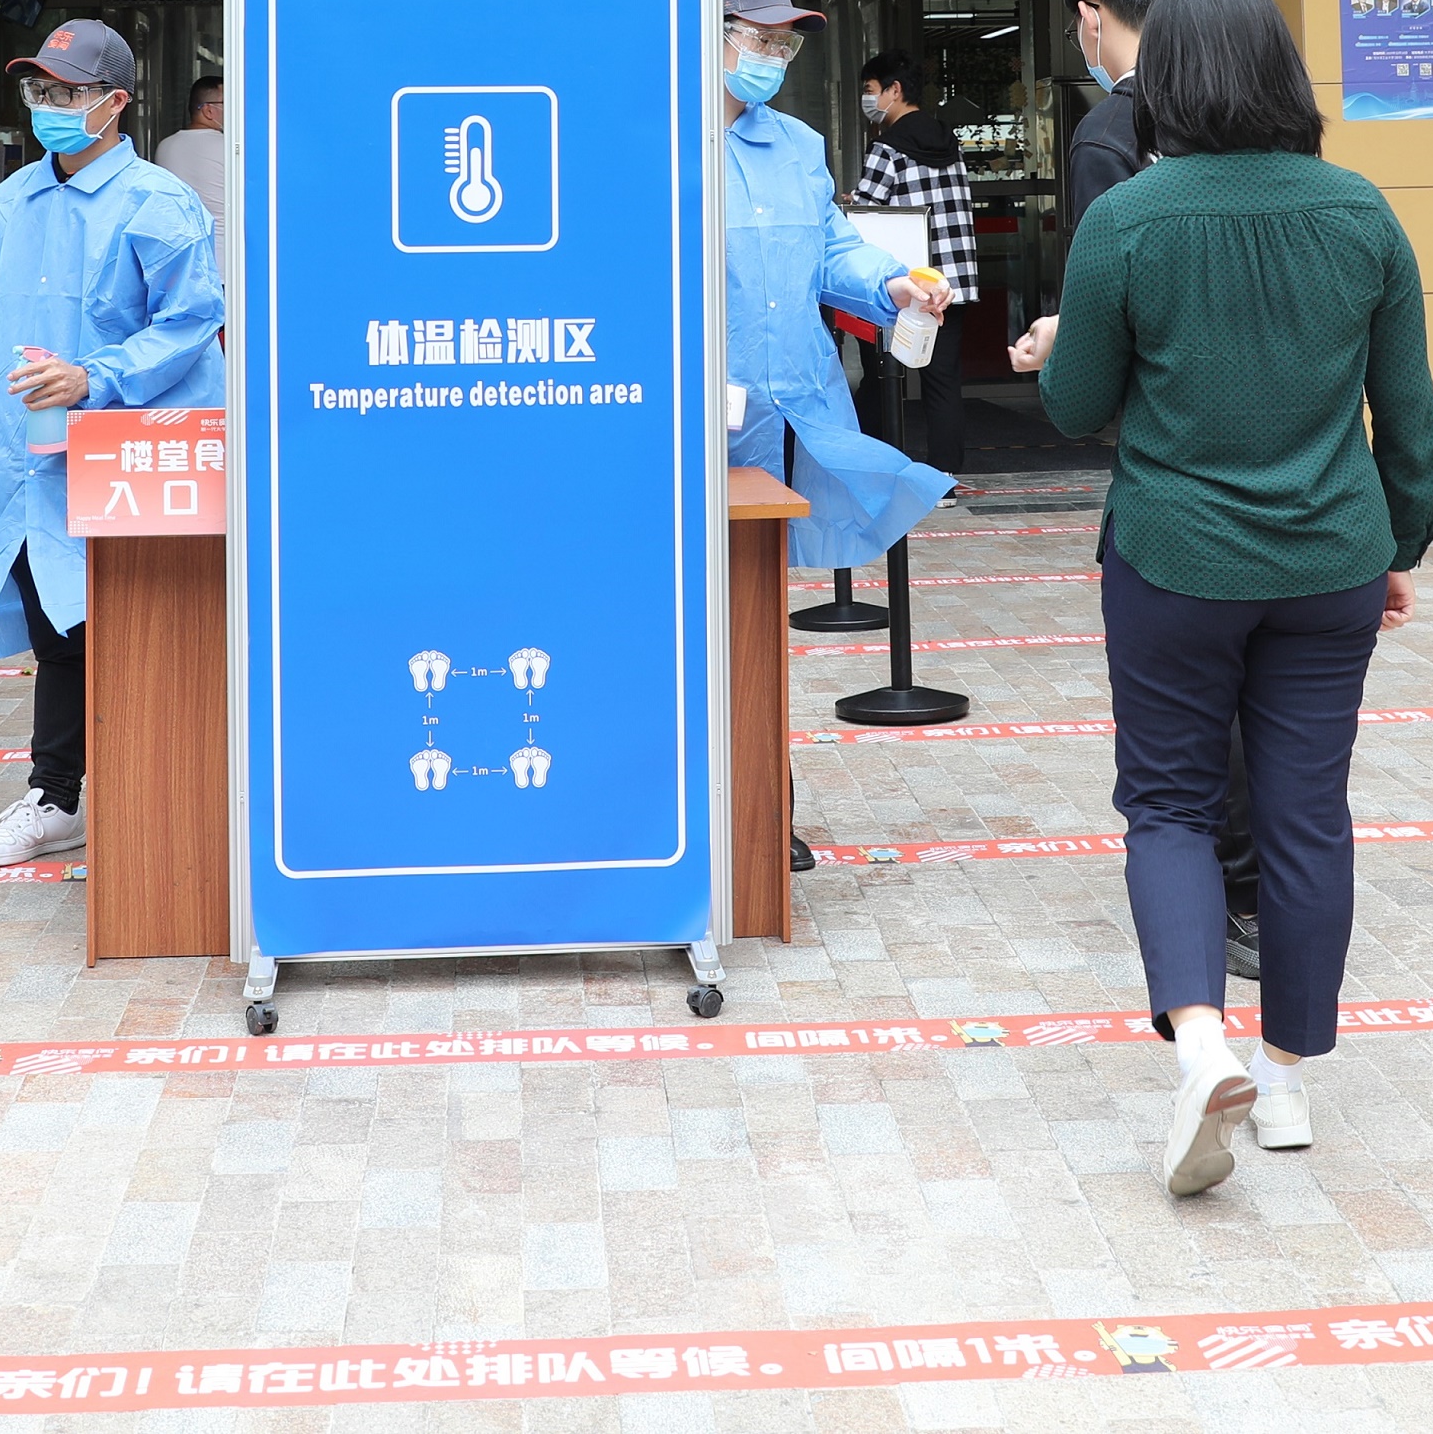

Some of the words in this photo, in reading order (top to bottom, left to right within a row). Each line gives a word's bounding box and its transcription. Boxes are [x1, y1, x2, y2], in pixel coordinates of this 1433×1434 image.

[365, 317, 597, 366] 体温检测区
[309, 379, 464, 416] Temperature
[468, 379, 584, 410] detection
[589, 382, 644, 407] area
[84, 439, 226, 472] 一楼堂食
[104, 479, 199, 517] 入口
[470, 665, 489, 678] 1m
[422, 714, 439, 726] 1m
[522, 712, 540, 723] 1m
[471, 764, 489, 776] 1m
